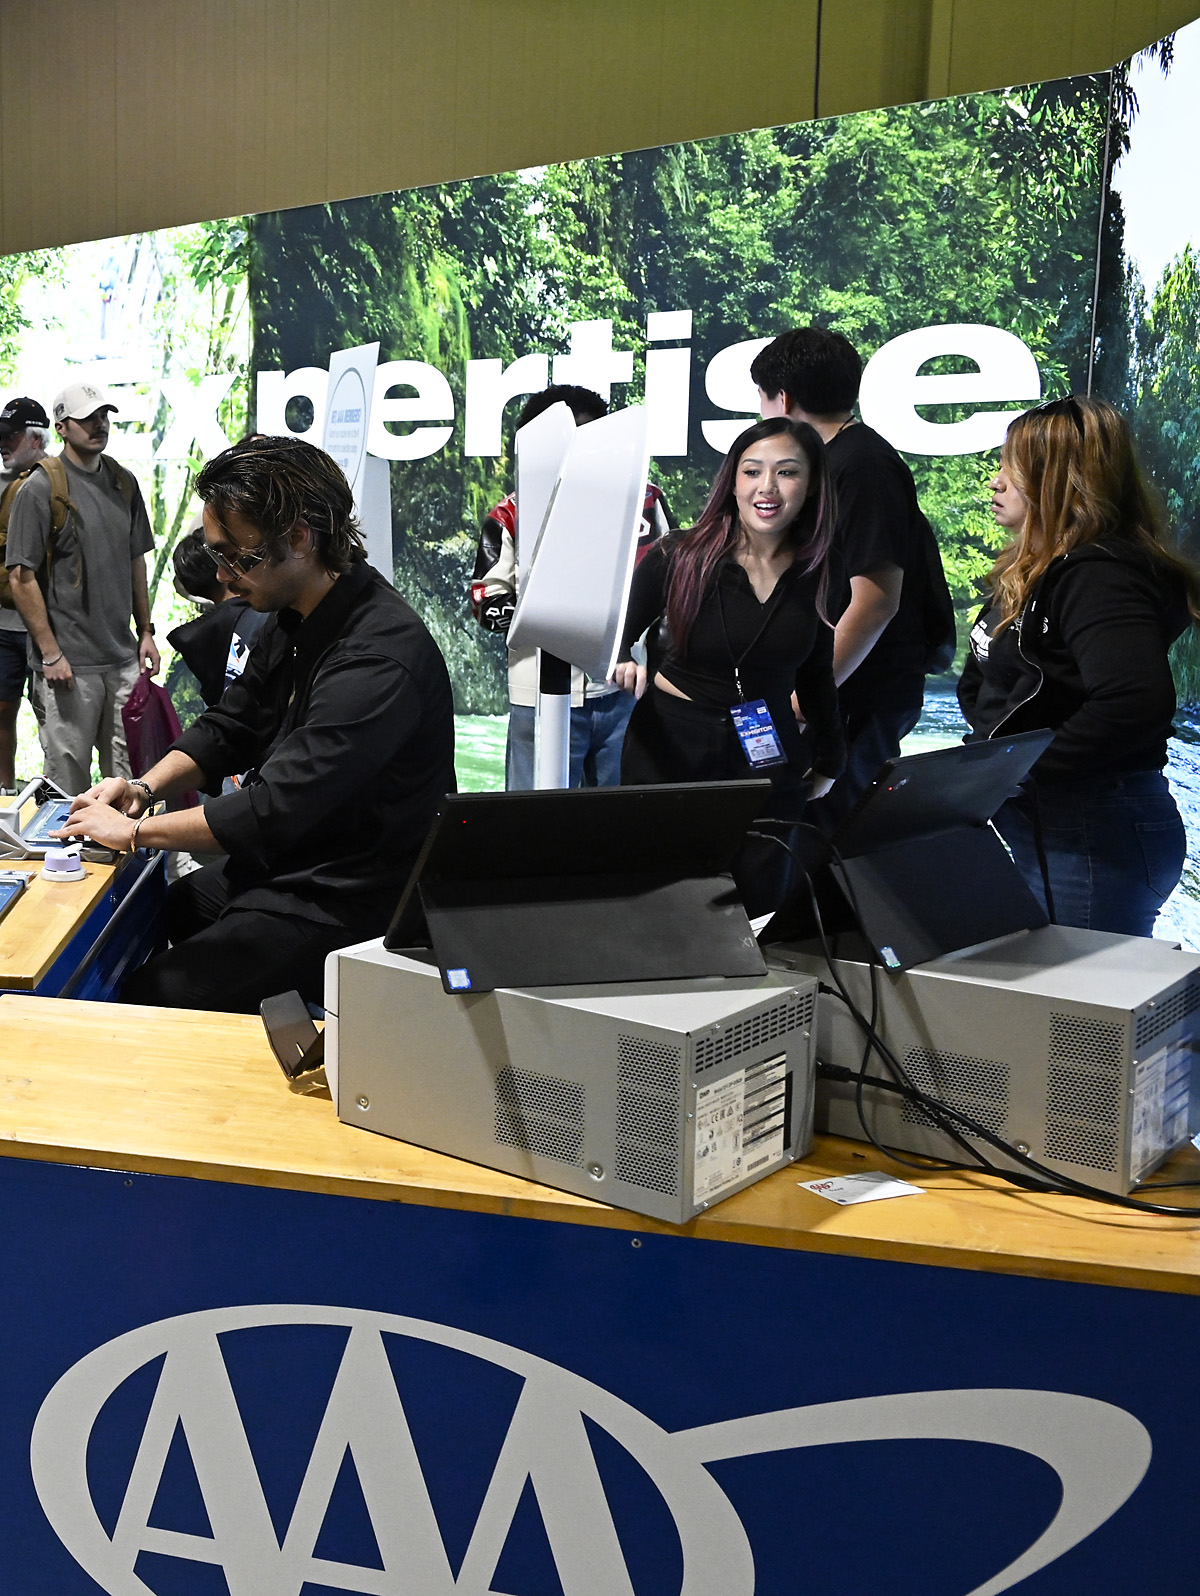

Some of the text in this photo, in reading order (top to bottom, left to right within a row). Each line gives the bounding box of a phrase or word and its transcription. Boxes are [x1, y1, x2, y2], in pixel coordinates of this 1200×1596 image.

[81, 386, 98, 399] LA
[740, 725, 774, 738] EXHIBITOR
[108, 1322, 638, 1596] AAA
